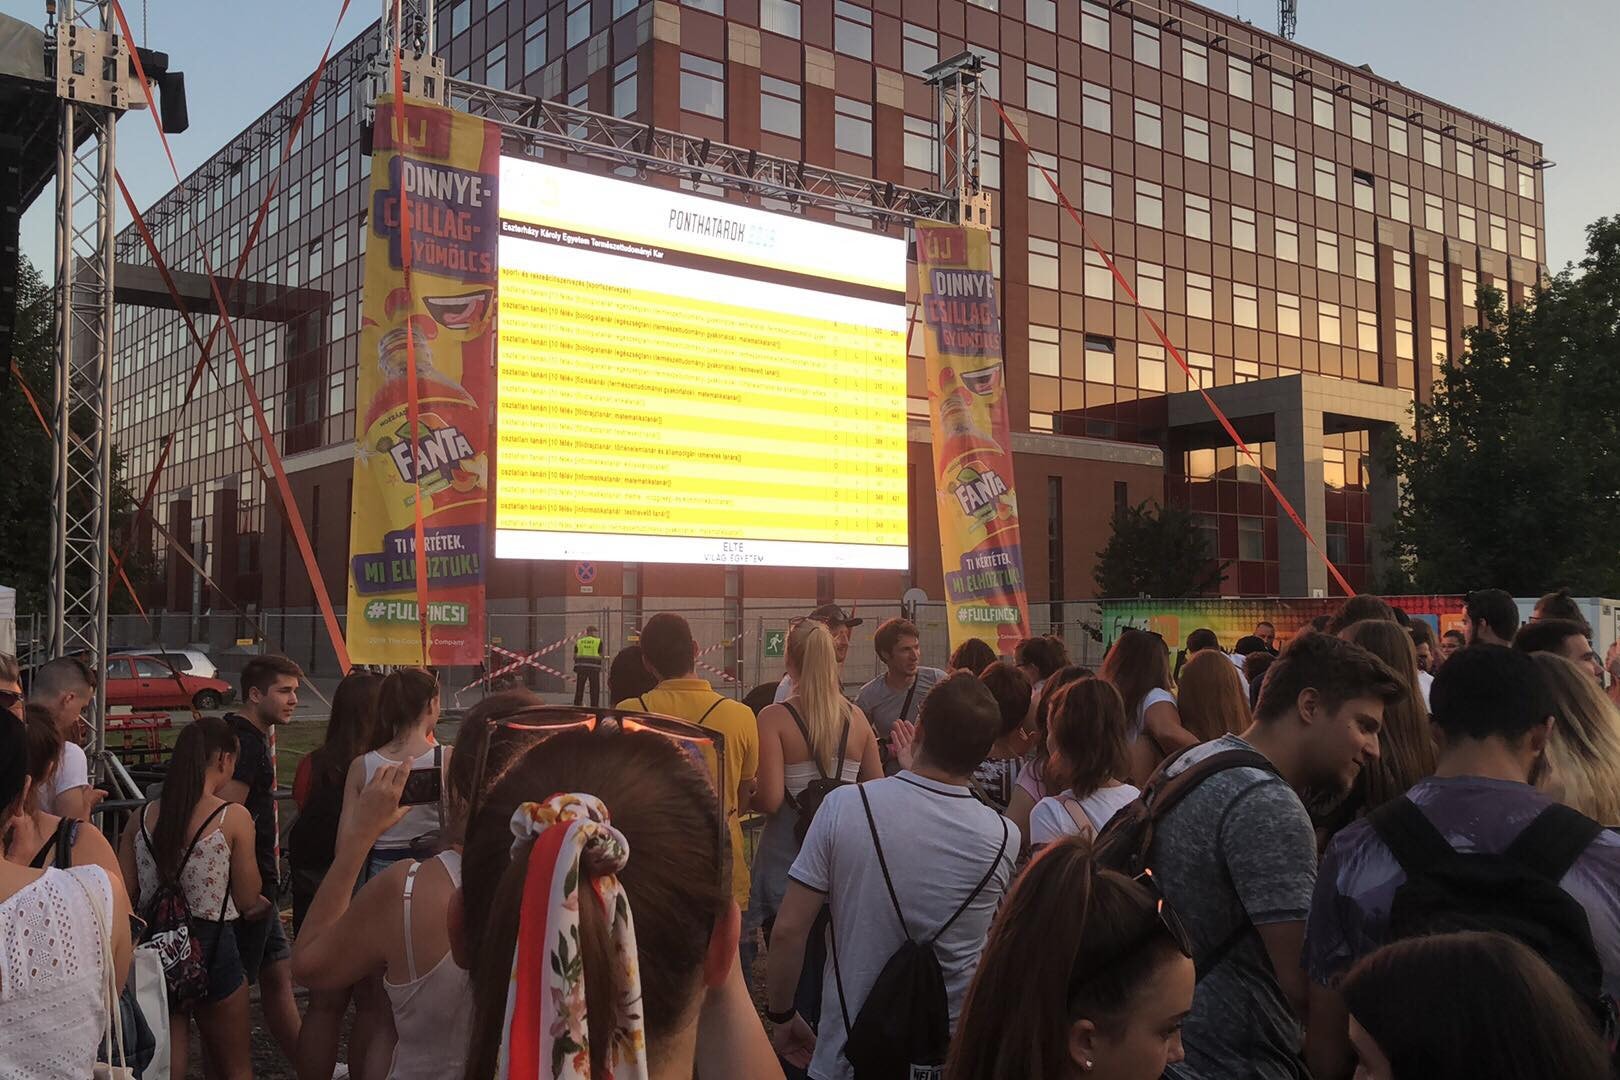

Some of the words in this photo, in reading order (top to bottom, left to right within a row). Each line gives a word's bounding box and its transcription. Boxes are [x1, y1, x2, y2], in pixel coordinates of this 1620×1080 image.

[402, 160, 491, 207] DINNYE-
[669, 209, 746, 242] PONTHATÁROK
[502, 222, 540, 238] Eszterházy
[540, 229, 562, 241] Károly
[562, 233, 590, 246] Egyetem
[591, 238, 652, 257] Természettudományi
[652, 250, 664, 259] Kar
[411, 237, 490, 273] YÜMÖLCS
[391, 427, 474, 481] FANTA
[955, 471, 1007, 514] FANTA
[395, 538, 407, 553] TI
[411, 531, 465, 552] KRTÉTEK,
[723, 542, 744, 553] ELTE
[364, 561, 386, 583] MI
[966, 558, 975, 570] TI
[953, 577, 964, 592] MI
[958, 607, 1018, 621] #FULLFINCSI
